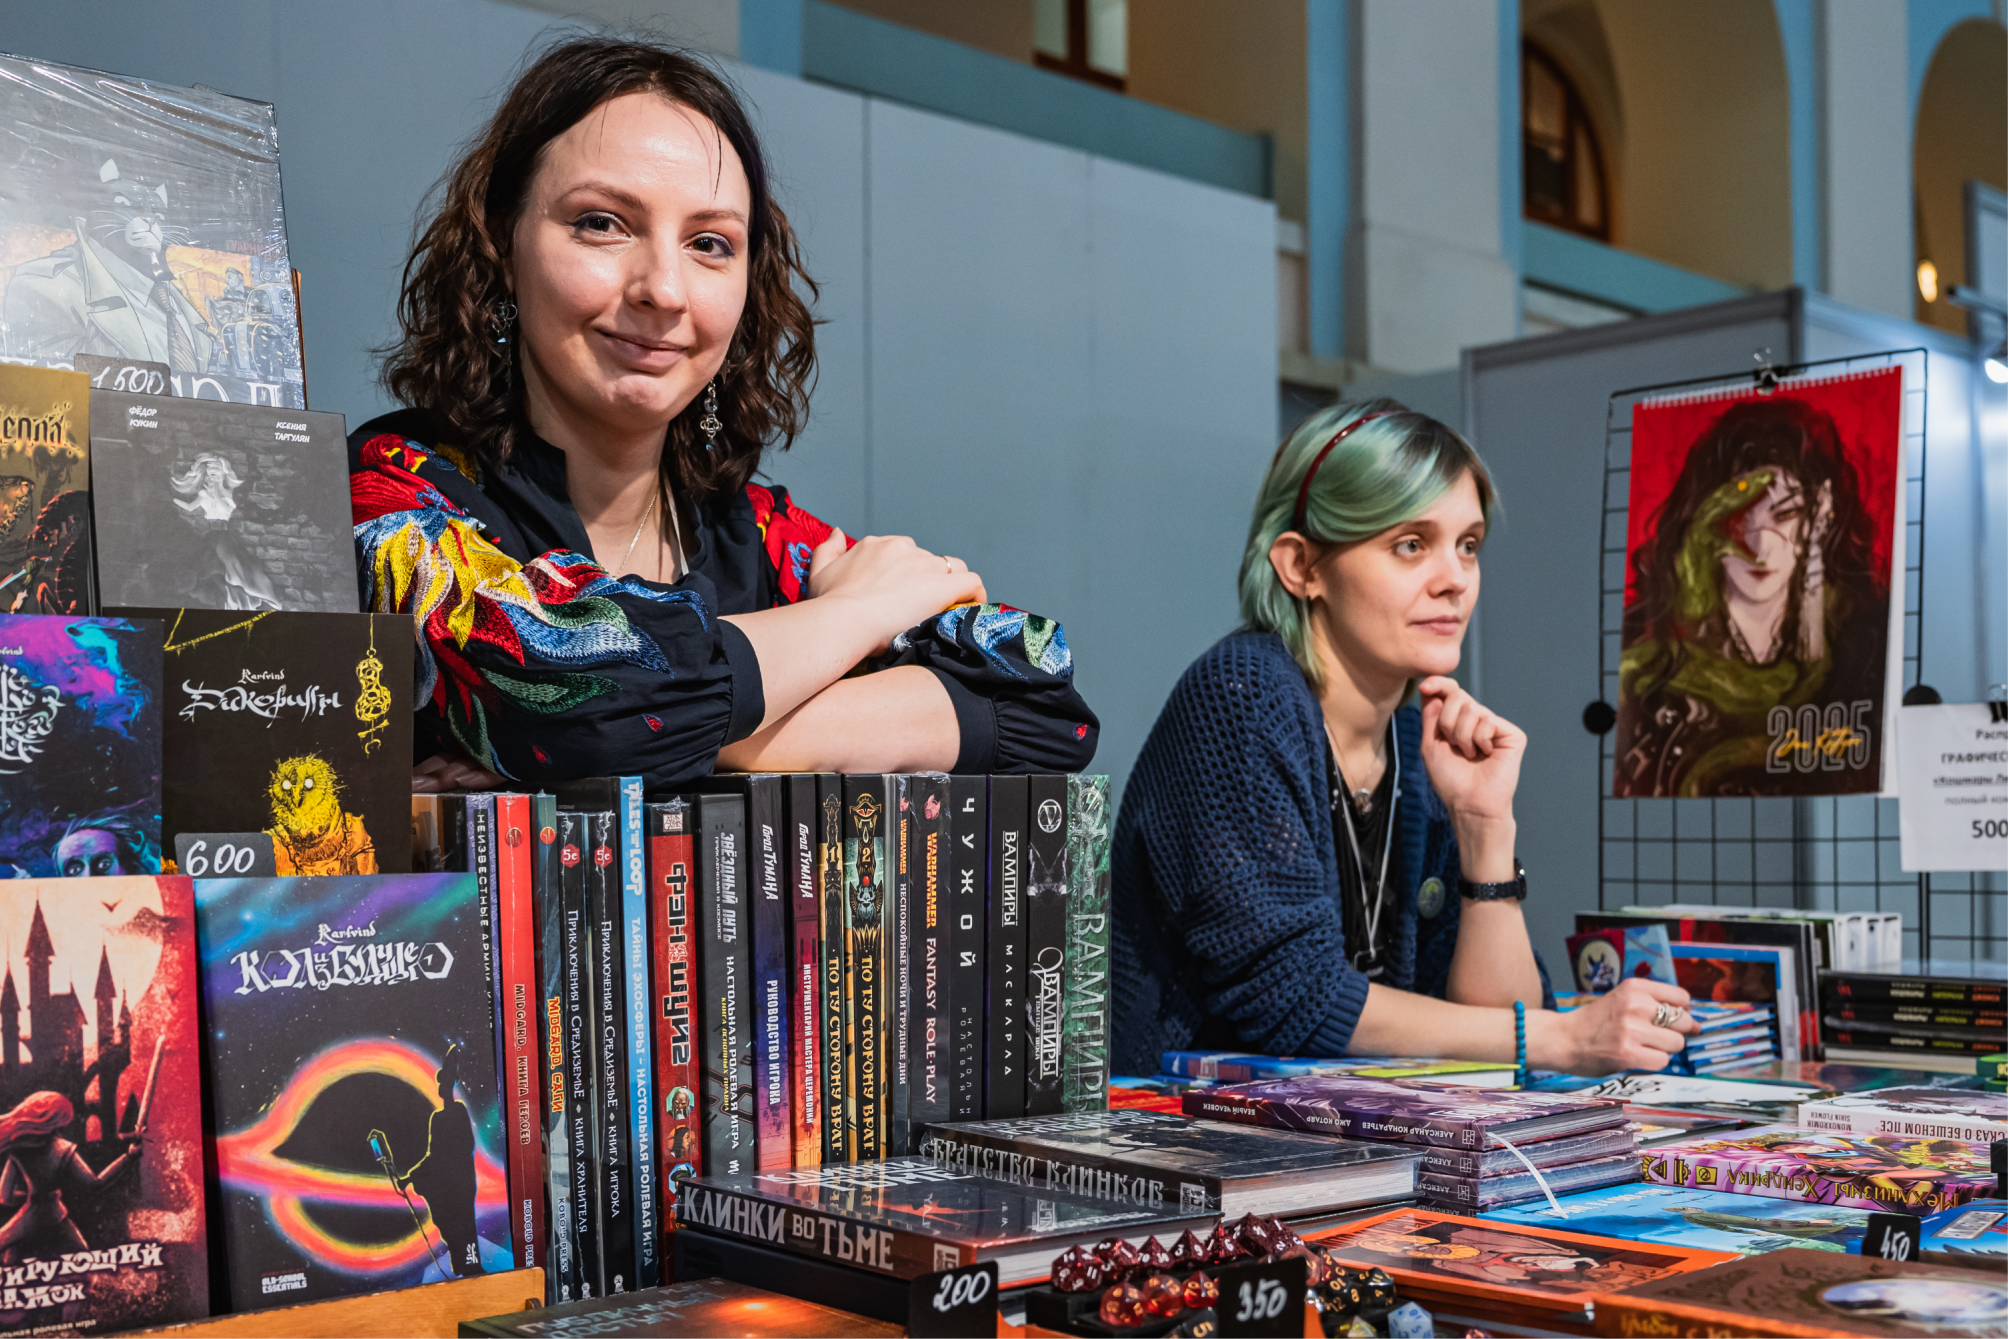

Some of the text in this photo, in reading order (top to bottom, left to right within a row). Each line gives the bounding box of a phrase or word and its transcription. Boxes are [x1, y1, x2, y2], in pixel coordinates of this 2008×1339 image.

[128, 405, 158, 417] ФЁДОР
[129, 417, 158, 430] КУКИН
[276, 420, 307, 432] КСЕНИЯ
[274, 431, 310, 443] ТАРГУЛЯН
[1766, 698, 1873, 774] 2025
[186, 838, 256, 877] 600
[476, 813, 490, 928] НЕИЗВЕСТНЫЕ
[625, 848, 643, 896] LOOP
[1002, 831, 1018, 926] ВАМПИРЫ
[720, 832, 738, 943] ЗВЁЗДНЫЙ ПУТЬ
[925, 831, 938, 930] WARHAMMER
[959, 797, 976, 967] ЧУЖОЙ
[899, 883, 907, 965] НЕСПОКОЙНЫЕ
[899, 966, 907, 997] НОЧИ
[926, 938, 937, 1009] FANTASY
[720, 996, 728, 1024] КНИГА
[726, 955, 737, 1047] НАСТОЛЬНАЯ
[766, 979, 781, 1105] РУКОВОДСТВО ИГРОКА
[803, 963, 815, 1124] ИНСТРУМЕНТАРИЙ МАСТЕРА ЦЕРЕМОНИЙ
[899, 1009, 907, 1060] ТРУДНЫЕ
[1041, 973, 1059, 1080] ВАМПИРЫ
[516, 1055, 529, 1096] КНИГА
[828, 956, 842, 1151] ПО ТУ СТОРОНУ ВРАТ
[861, 955, 875, 1152] ПО ТУ СТОРОНУ ВРАТ
[898, 1061, 907, 1085] ДНИ
[550, 1072, 565, 1112] САГИ
[631, 917, 654, 1267] ТАЙНЫ ЭХОСФЕРЫ НАСТОЛЬНАЯ РОЛЕВАЯ ИГРА
[728, 1049, 738, 1111] РОЛЕВАЯ
[518, 1099, 531, 1145] ГЕРОЕВ
[730, 1114, 740, 1150] ИГРА
[1202, 1102, 1256, 1117] БЕЛЫЙ ЧЕЛОВЕК
[1305, 1115, 1352, 1128] ДЖО КОТЛЯР
[1361, 1121, 1455, 1140] АЛЕКСАНДР КОНДРАТЬЕВ
[1879, 1119, 1902, 1132] ПСЕ
[1904, 1121, 1962, 1139] БЕШЕНОМ
[575, 1117, 585, 1157] КНИГА
[608, 1125, 618, 1166] КНИГА
[1964, 1128, 1973, 1139] О
[610, 1169, 620, 1218] ИГРОКА
[931, 1137, 1037, 1187] БРАТСТВО
[1046, 1159, 1165, 1210] КЛИНКОВ
[576, 1161, 588, 1233] ХРАНИТЕЛЯ
[522, 1198, 534, 1242] KOBOLD
[557, 1197, 569, 1272] KOBOLD PRESS
[683, 1185, 787, 1245] КЛИНКИ
[791, 1212, 816, 1241] ВО
[818, 1216, 895, 1271] ТЬМЕ
[0, 1243, 164, 1287] ИРУЮЩИЙ
[0, 1283, 86, 1310] АМОК
[932, 1270, 992, 1314] 200
[1236, 1277, 1288, 1322] 350
